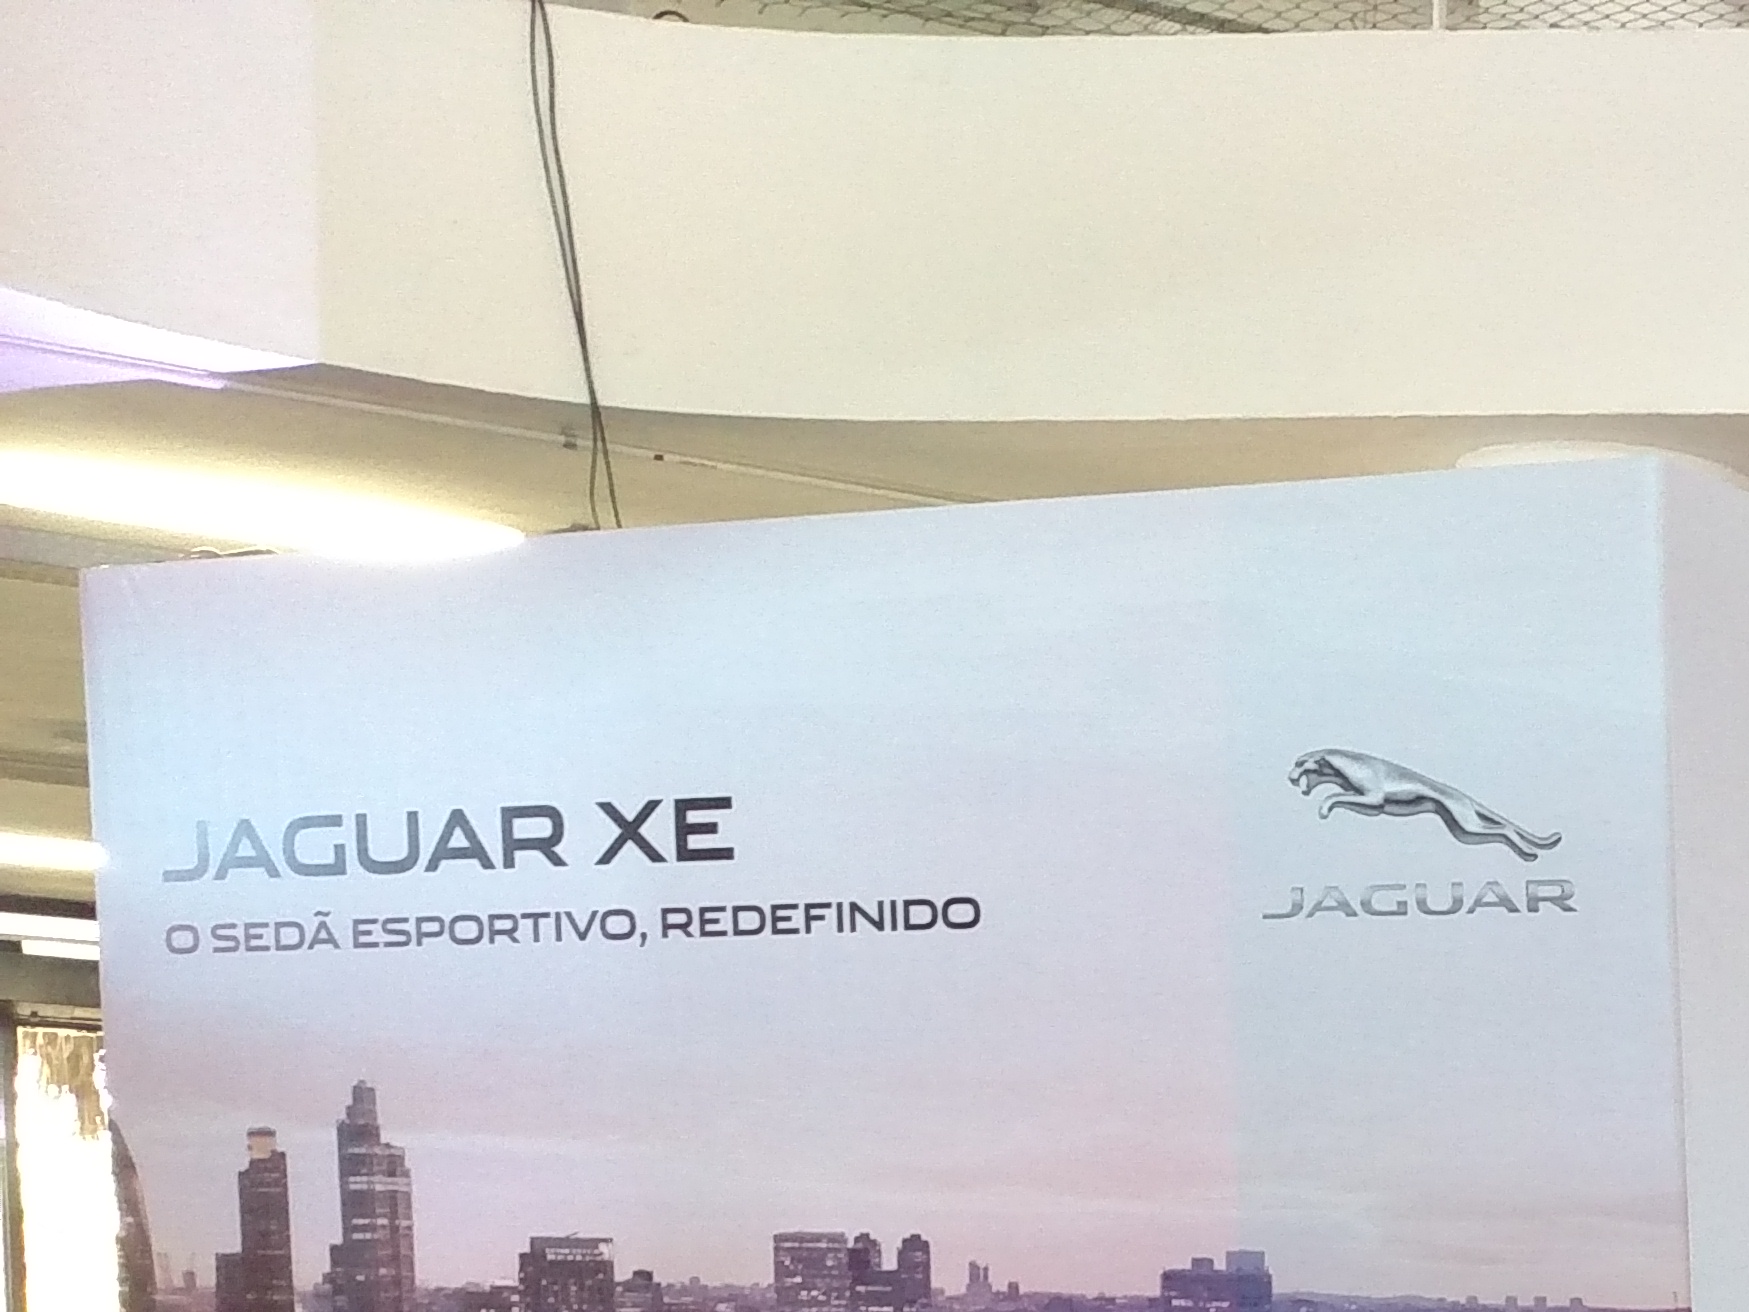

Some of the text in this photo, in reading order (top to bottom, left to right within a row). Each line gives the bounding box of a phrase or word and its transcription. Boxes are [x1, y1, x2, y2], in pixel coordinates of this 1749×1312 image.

[162, 795, 737, 883] JAGUAR XE
[164, 895, 983, 956] O SEDÃ ESPORTIVO, REDEFINIDO
[1261, 878, 1580, 920] JAGUAR
